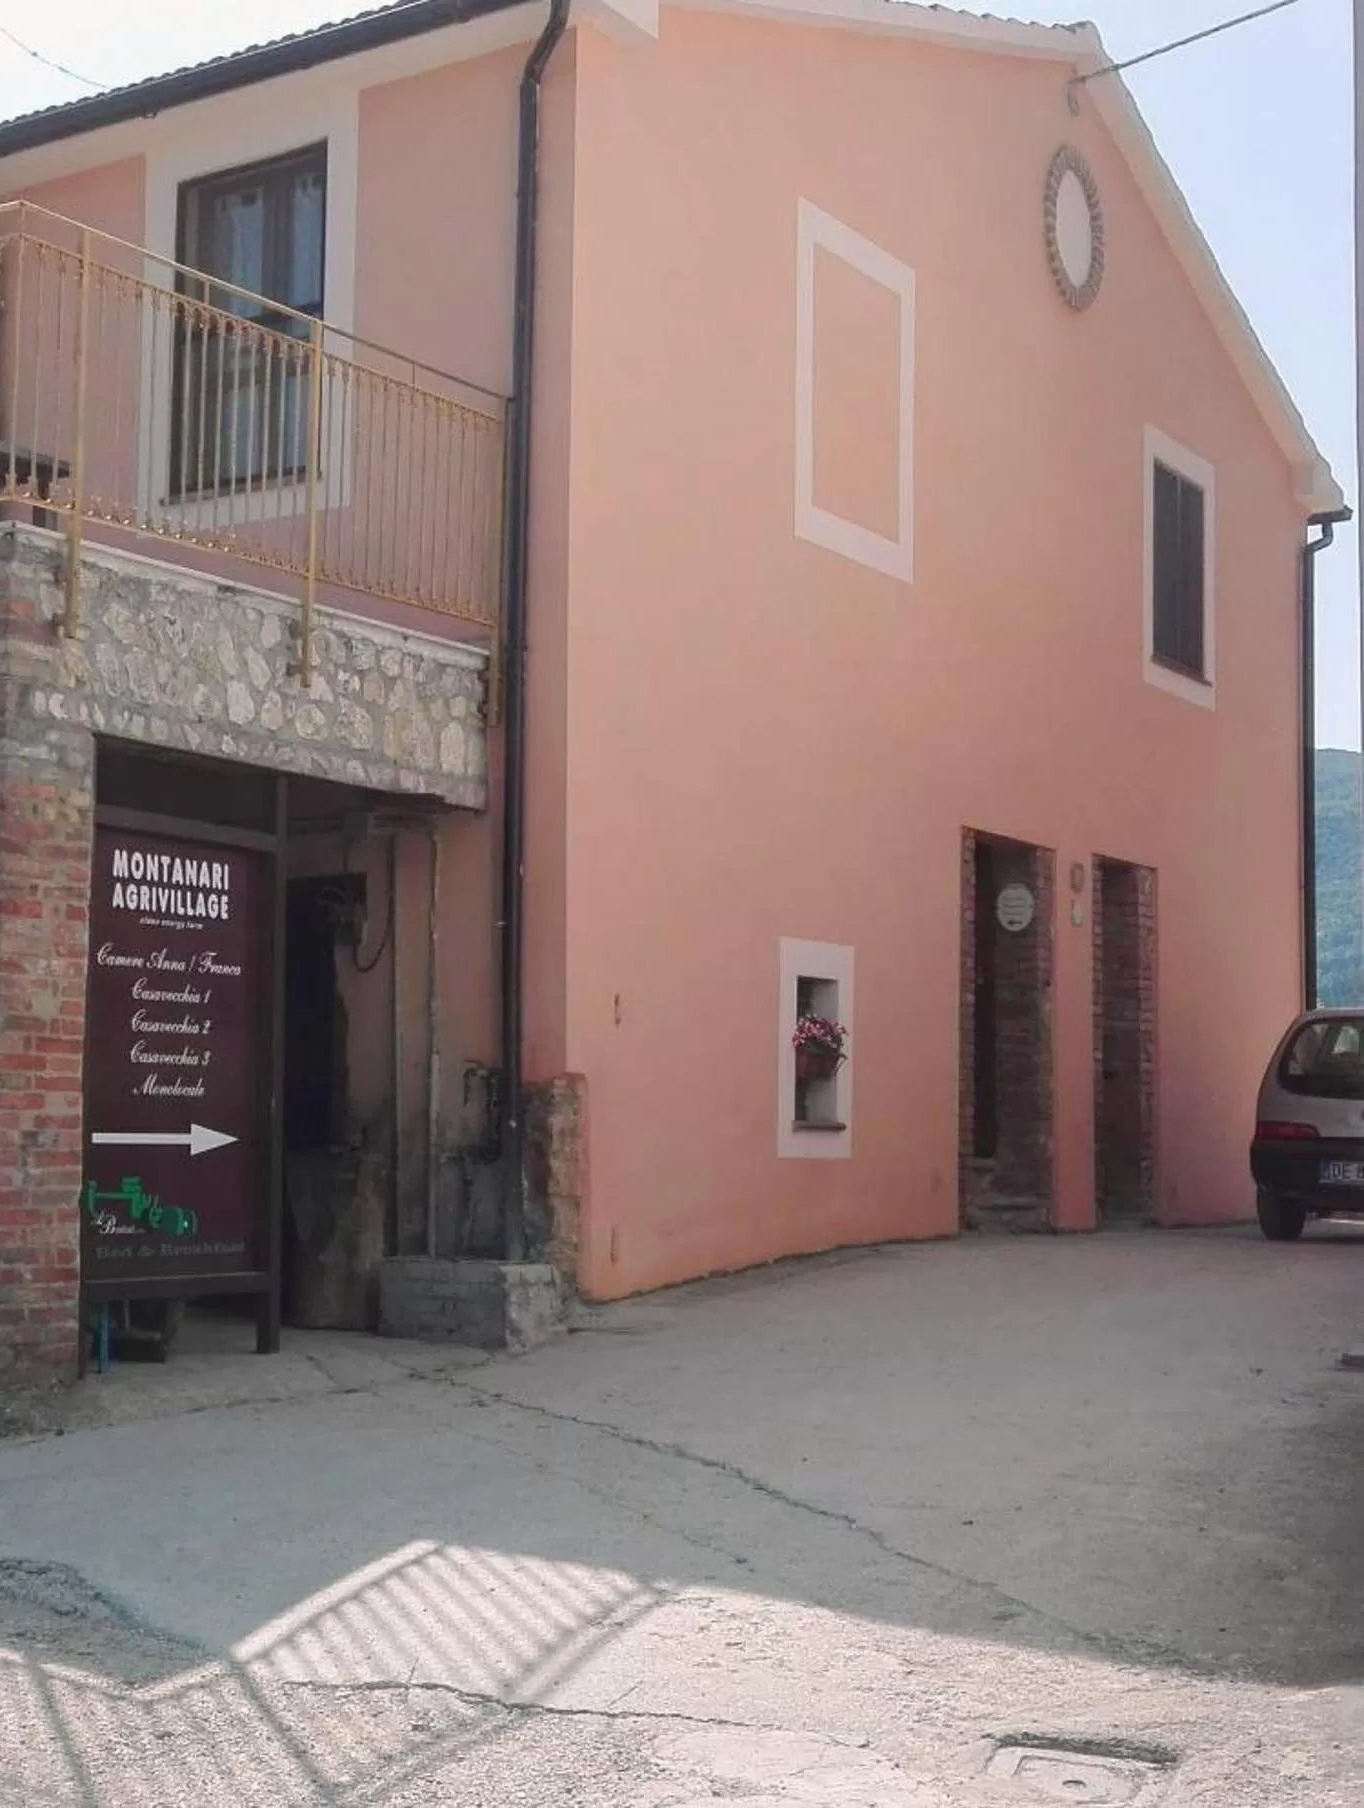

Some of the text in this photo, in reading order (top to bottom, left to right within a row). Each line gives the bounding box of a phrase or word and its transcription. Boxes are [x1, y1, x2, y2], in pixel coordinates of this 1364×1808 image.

[113, 849, 229, 890] MONTANARI
[112, 882, 229, 919] AGRIVILLAGE
[97, 942, 144, 969] Camere
[146, 948, 186, 971] Anna
[198, 951, 241, 976] Franca
[132, 977, 212, 1004] Casavecchia 1
[132, 1008, 211, 1034] Casavecchia 2
[130, 1039, 211, 1066] Casavecchia 3
